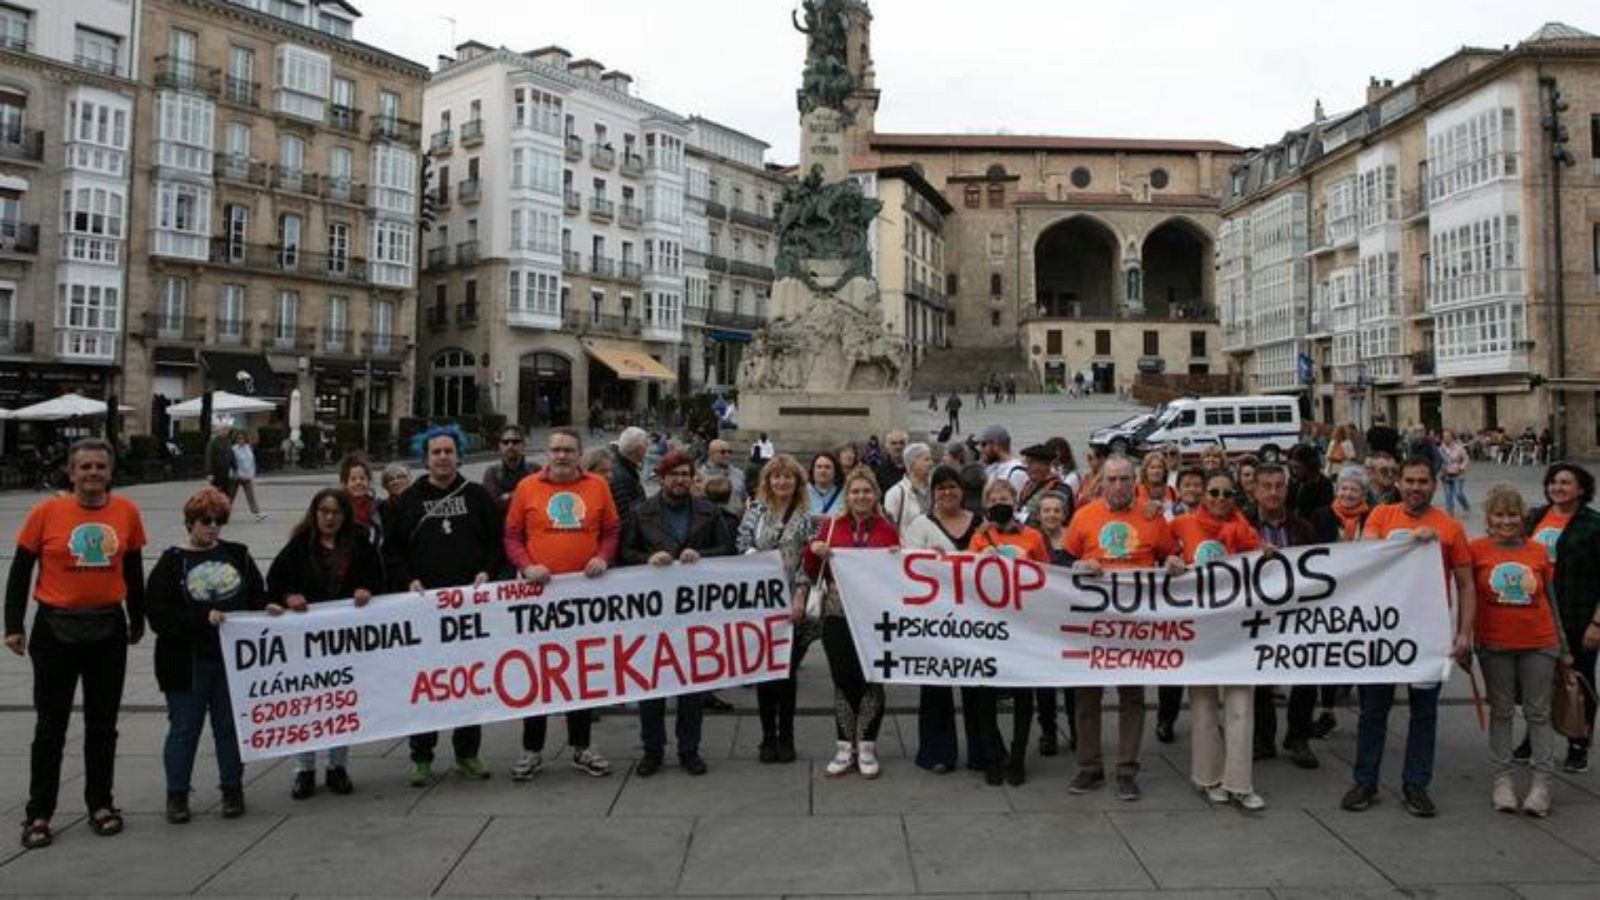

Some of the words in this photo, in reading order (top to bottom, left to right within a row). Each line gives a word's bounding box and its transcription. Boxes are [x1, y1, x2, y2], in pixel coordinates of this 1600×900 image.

[437, 589, 463, 609] 30
[497, 582, 544, 600] MARZO
[903, 552, 1046, 610] STOP
[1070, 547, 1337, 613] SUICIDIOS
[235, 628, 287, 670] DÍA
[304, 620, 422, 658] MUNDIAL
[440, 612, 490, 643] DEL
[508, 590, 663, 634] TRASTORNO
[675, 578, 787, 615] BIPOLAR
[411, 661, 491, 704] ASOC.
[494, 614, 791, 709] OREKABIDE
[1254, 638, 1418, 671] PROTEGIDO
[248, 666, 354, 699] LLÁMANOS
